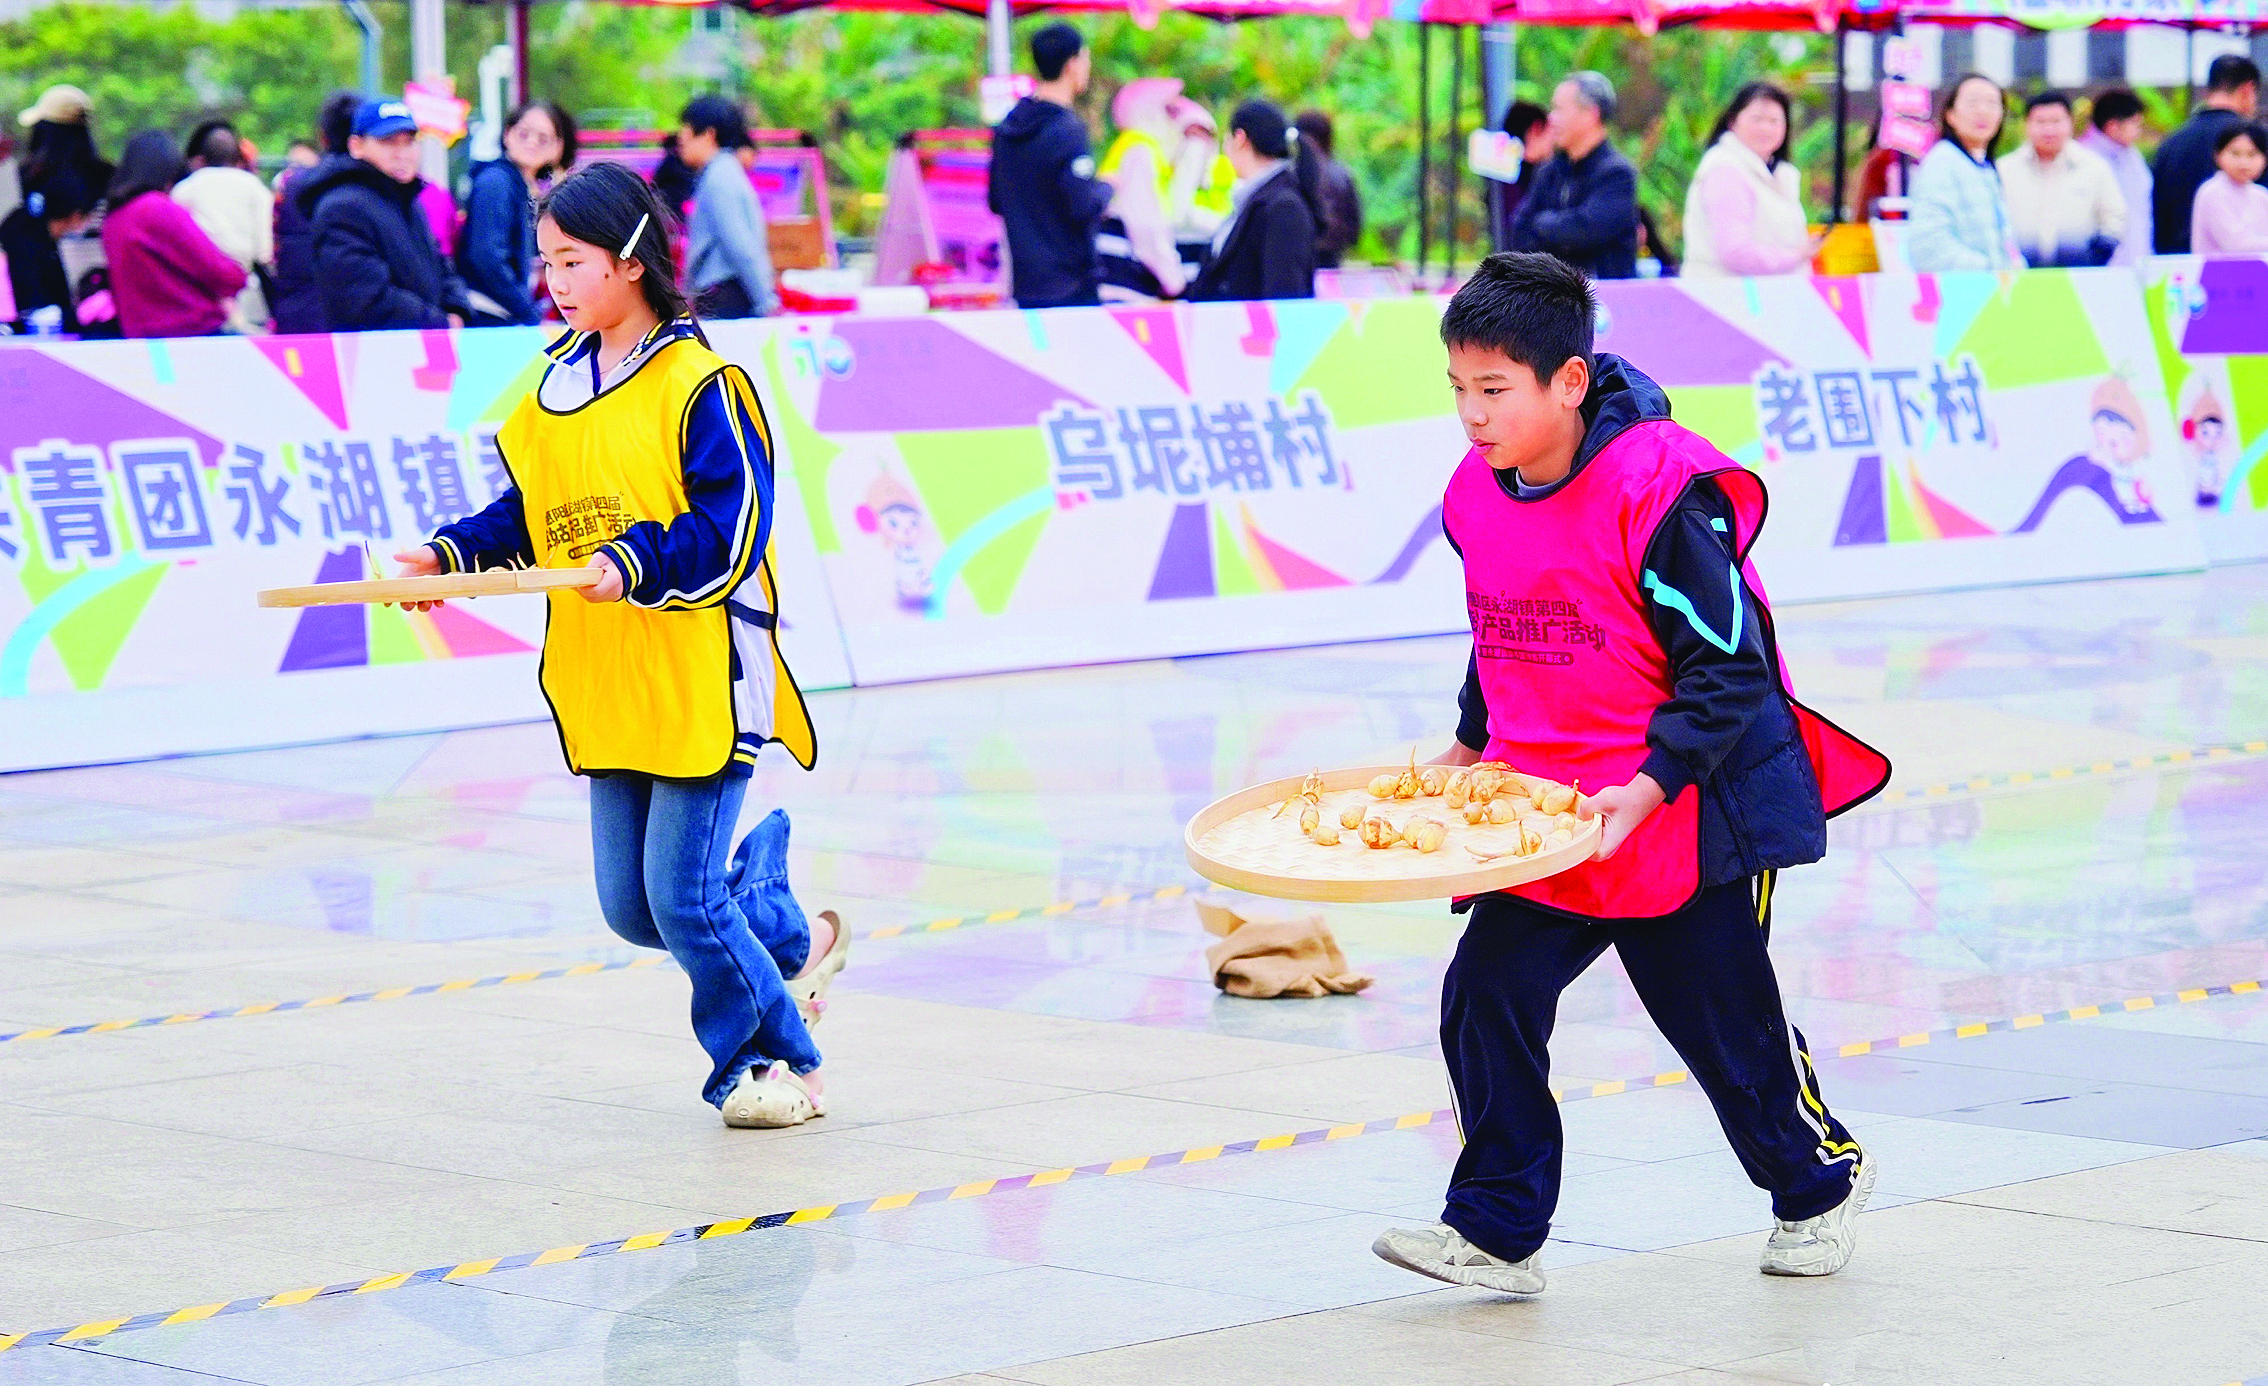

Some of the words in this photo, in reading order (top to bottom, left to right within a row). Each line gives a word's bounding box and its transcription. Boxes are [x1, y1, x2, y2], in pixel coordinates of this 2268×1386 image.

[1049, 398, 1338, 500] 乌坭埔村
[1760, 361, 1988, 453] 老围下村
[0, 434, 508, 560] 青团永湖镇
